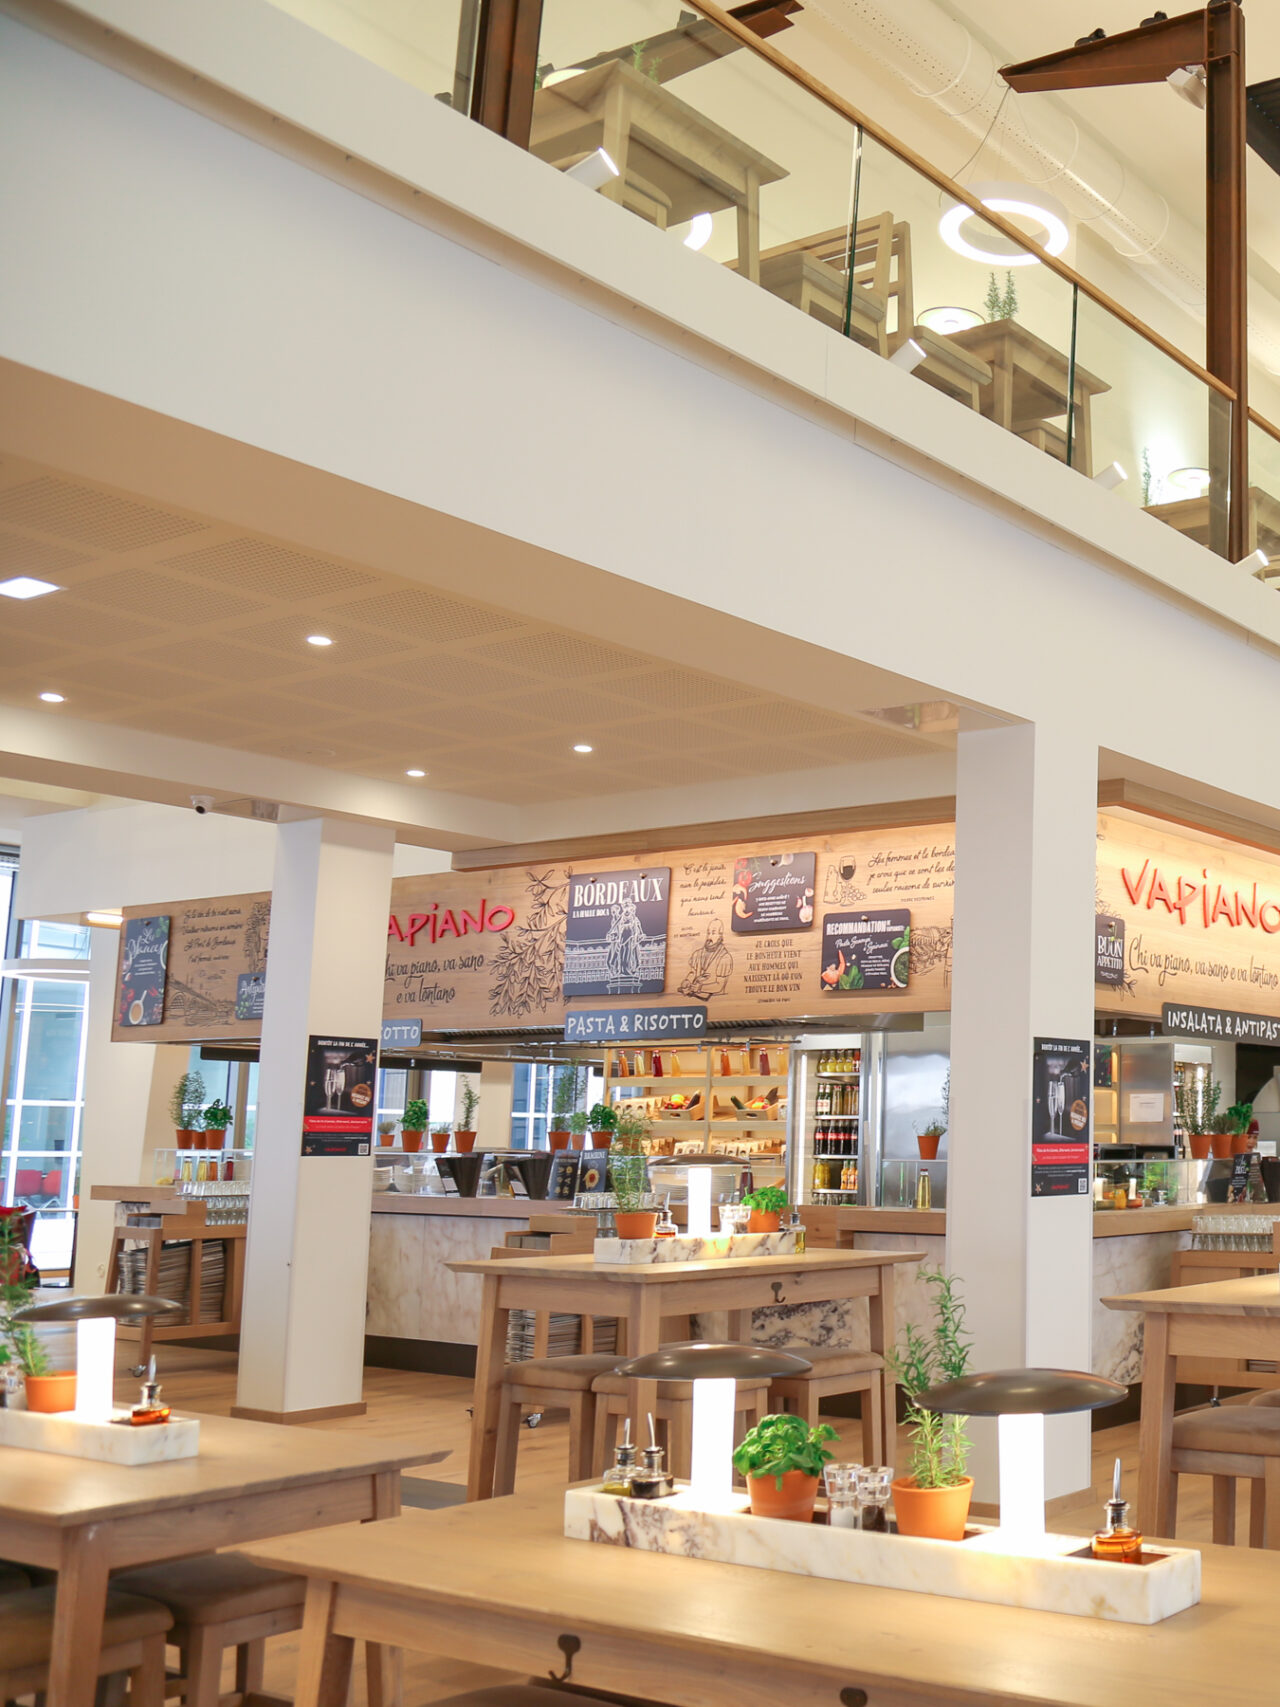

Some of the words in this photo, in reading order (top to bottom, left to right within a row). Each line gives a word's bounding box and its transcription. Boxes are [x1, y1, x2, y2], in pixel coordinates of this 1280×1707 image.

[922, 848, 929, 859] le
[894, 870, 906, 882] que
[935, 861, 945, 872] les
[573, 878, 664, 907] BORDEAUX
[748, 871, 806, 895] Suggestions
[921, 877, 930, 889] de
[746, 952, 753, 960] LE
[1097, 935, 1123, 958] BUON
[385, 953, 396, 982] hi
[396, 962, 408, 976] va
[404, 958, 441, 988] piano,
[443, 959, 456, 970] va
[458, 954, 485, 972] sano
[1129, 934, 1149, 974] Chi
[1150, 953, 1162, 968] va
[1159, 954, 1193, 987] piano,
[1195, 961, 1206, 975] va
[1207, 961, 1229, 982] sano
[1231, 967, 1236, 980] e
[1237, 969, 1247, 982] va
[1250, 955, 1279, 990] lontano
[396, 992, 402, 1004] e
[404, 990, 416, 1002] va
[419, 978, 456, 1004] lontano
[768, 984, 774, 992] LE
[776, 984, 788, 992] BON
[789, 983, 800, 991] VIN
[382, 1026, 419, 1041] OTTO
[567, 1015, 615, 1035] PASTA
[620, 1015, 629, 1032] &
[634, 1013, 704, 1033] RISOTTO
[1168, 1010, 1222, 1035] INSALATA
[1225, 1016, 1232, 1035] &
